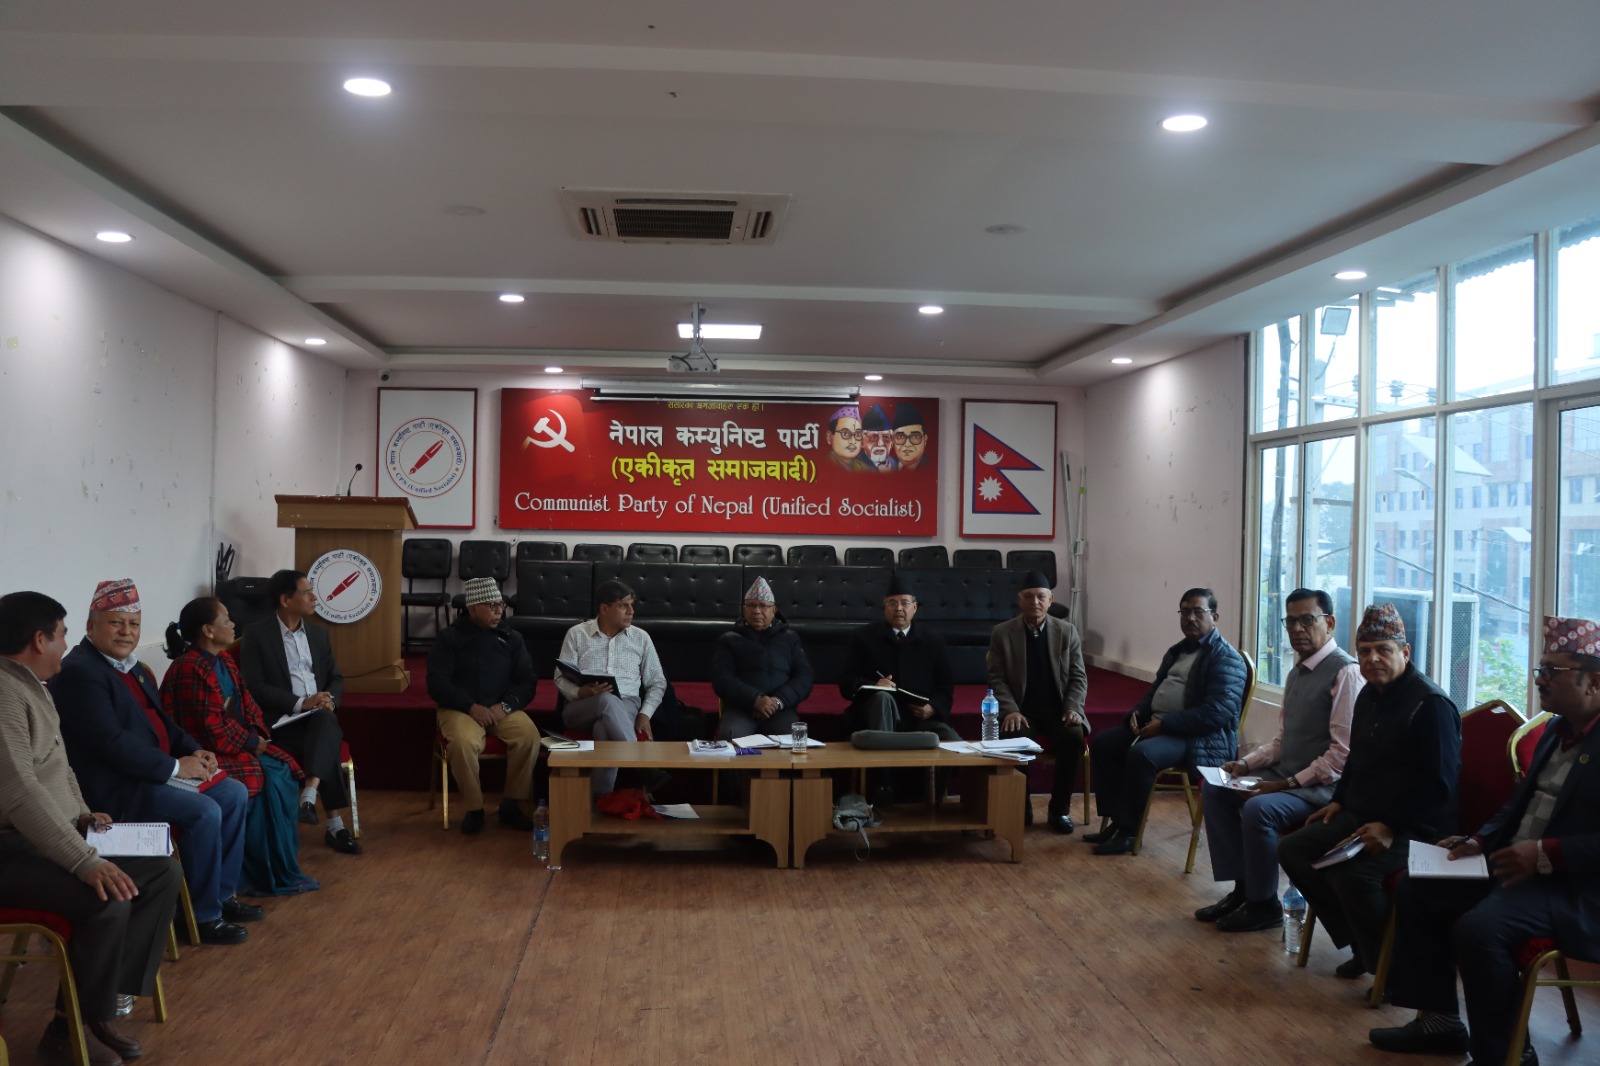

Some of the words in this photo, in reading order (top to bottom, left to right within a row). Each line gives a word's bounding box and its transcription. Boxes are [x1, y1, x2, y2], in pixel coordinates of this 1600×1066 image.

[609, 419, 663, 447] नेपाल
[676, 420, 767, 455] कम्युनिष्ट
[777, 423, 820, 450] पार्टी
[395, 472, 408, 486] CPN
[407, 483, 433, 494] (Unified
[433, 472, 458, 492] Socialist)
[611, 451, 695, 486] (एकीकृत
[707, 454, 817, 484] समाजवादी)
[514, 492, 610, 512] Communist
[618, 493, 668, 519] Party
[675, 493, 696, 513] of
[701, 495, 753, 520] Nepal
[762, 496, 831, 520] (Unified
[838, 497, 922, 522] Socialist)
[324, 610, 348, 620] (Unified
[348, 602, 372, 619] Socialist)
